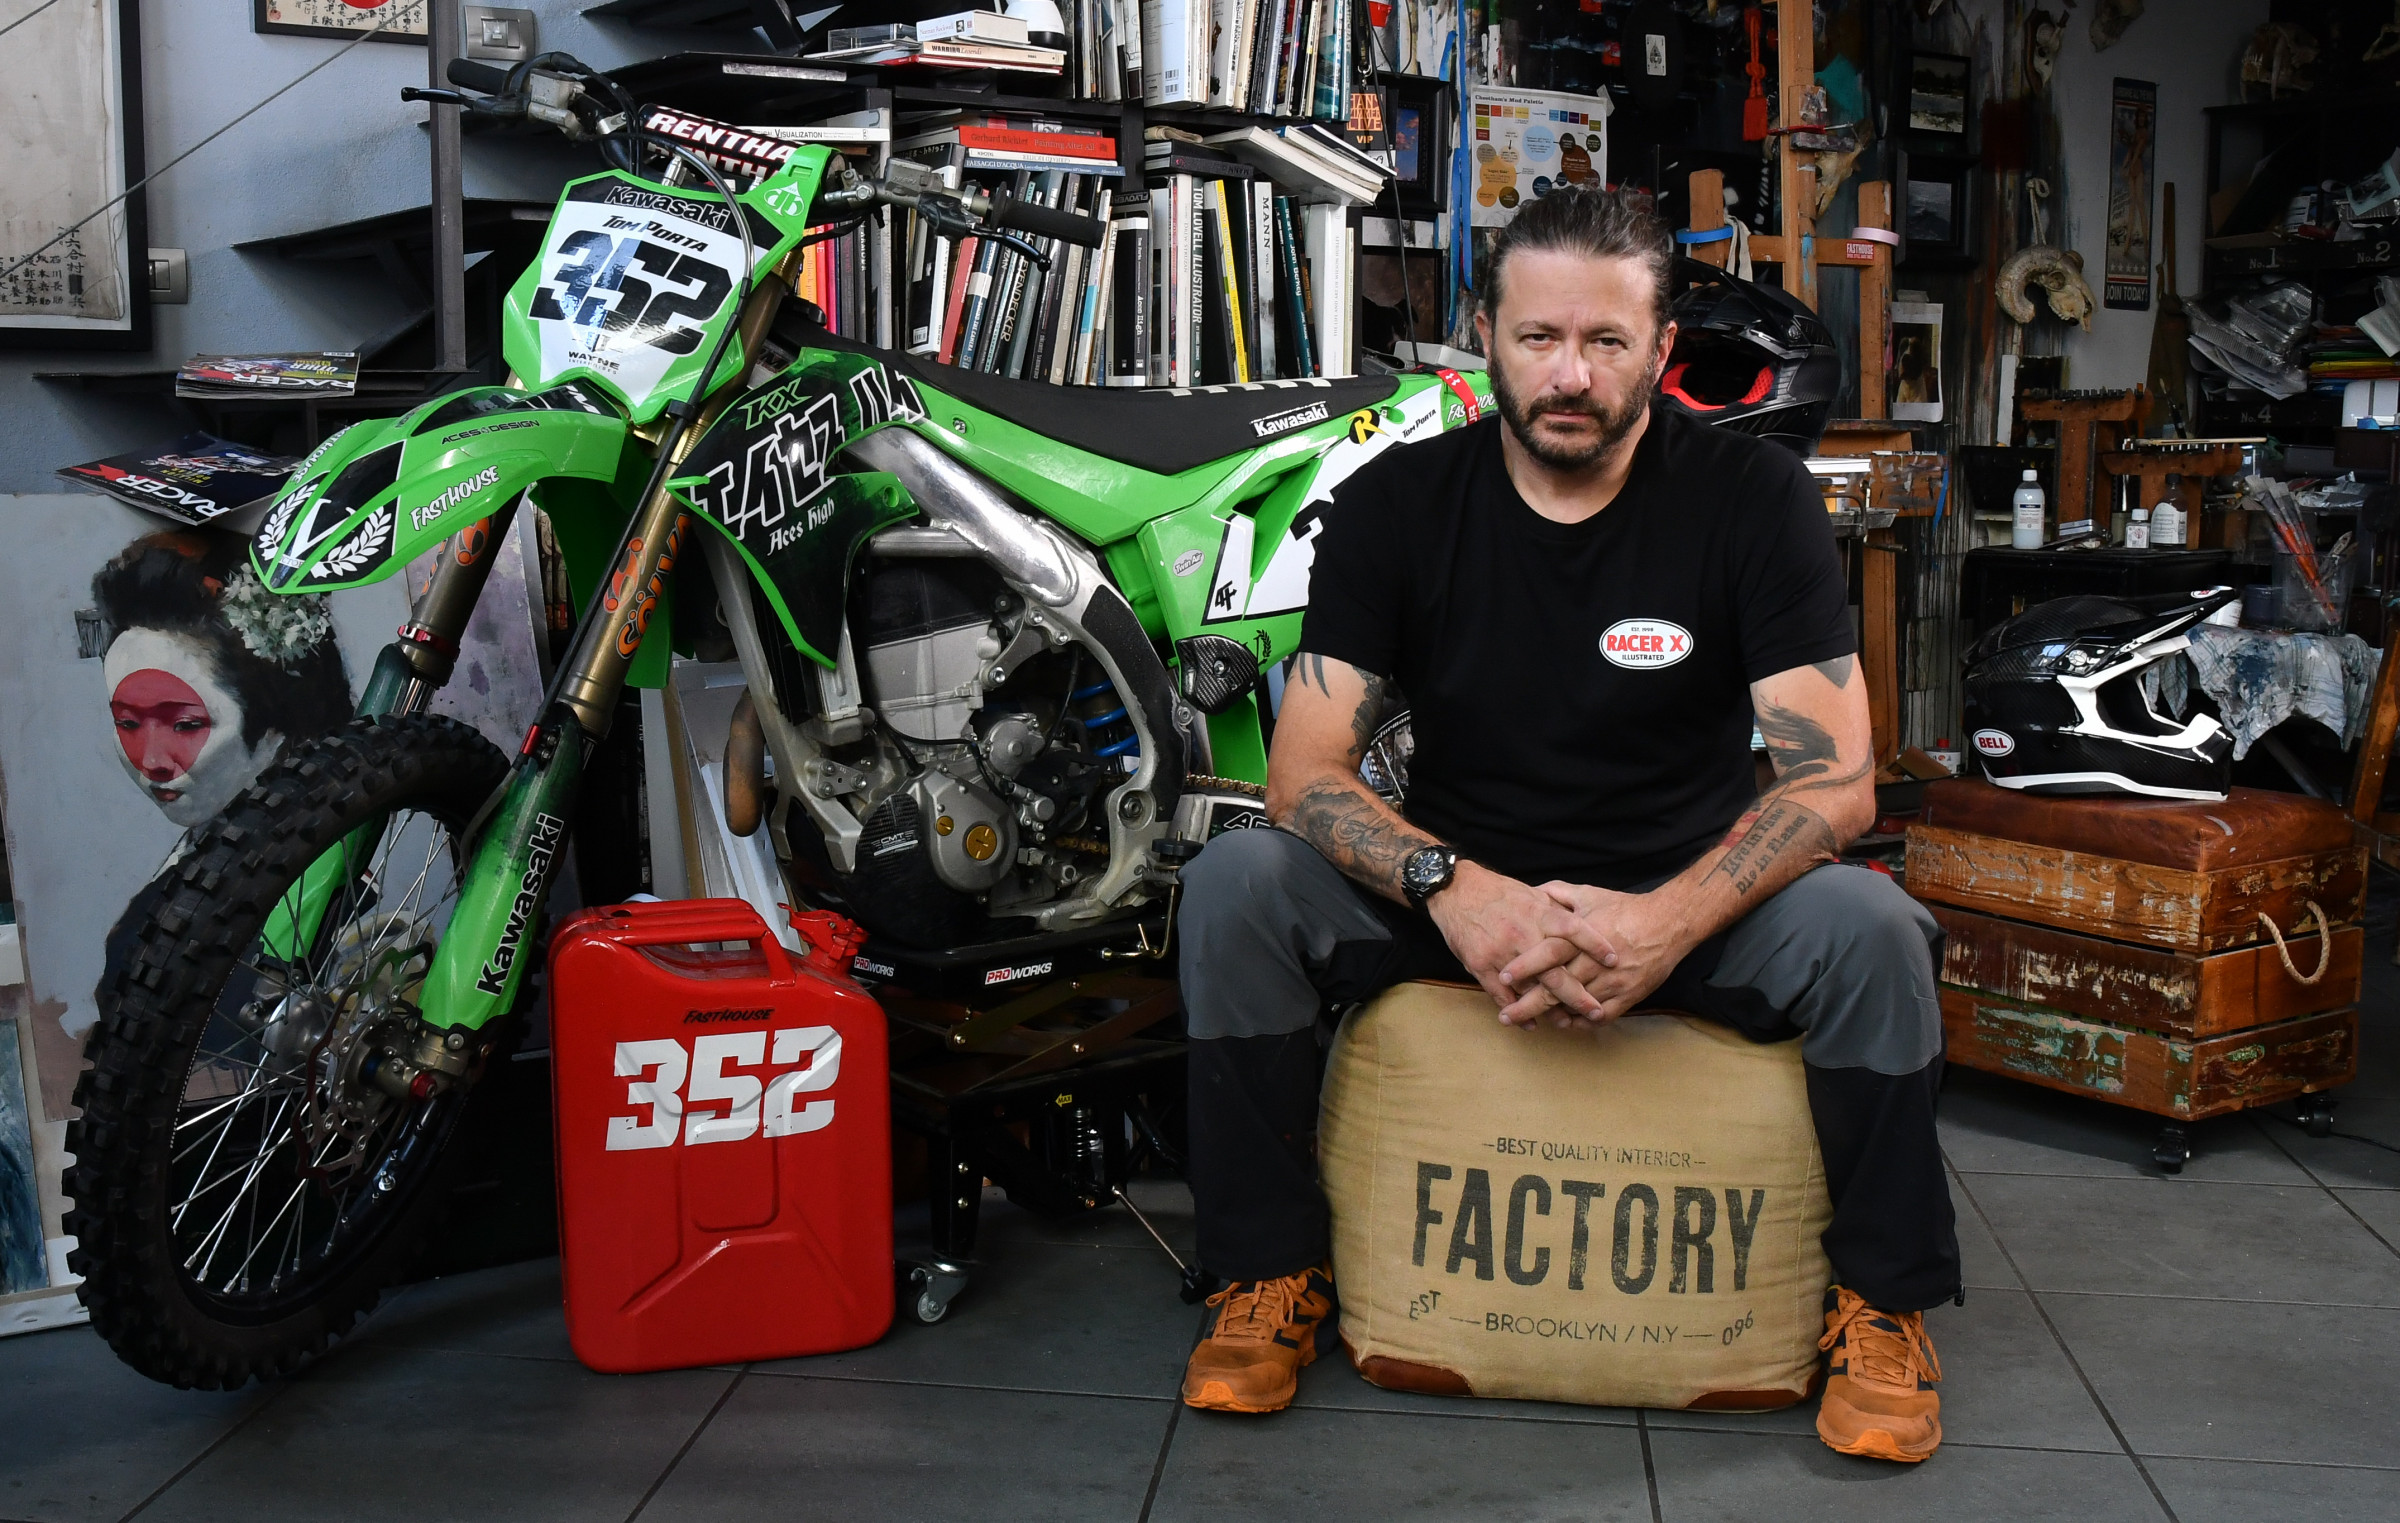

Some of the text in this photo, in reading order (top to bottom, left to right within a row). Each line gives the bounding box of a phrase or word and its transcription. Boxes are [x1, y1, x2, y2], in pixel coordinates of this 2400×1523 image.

[646, 111, 798, 163] RENTHA
[1348, 119, 1382, 130] LIVE
[604, 186, 730, 231] Kawasaki
[602, 214, 708, 253] TOM PORTA
[1262, 196, 1270, 250] MANN
[1288, 233, 1294, 241] of
[1192, 186, 1204, 323] TOM LOVELL ILLUSTRATOR
[1290, 244, 1298, 264] John
[527, 229, 733, 356] 352
[1293, 267, 1302, 297] Berkey
[2106, 284, 2148, 301] JOIN TODAY!
[1000, 258, 1029, 343] EYENDECKER
[1136, 315, 1144, 336] High
[290, 362, 338, 372] OTHER
[568, 350, 620, 371] WAYNE
[233, 372, 354, 388] RACER
[737, 377, 813, 431] KX
[1253, 402, 1330, 438] Kawasaki
[1416, 409, 1437, 428] PORTA
[441, 420, 540, 446] ACES DESIGN
[116, 474, 232, 518] RACER
[410, 466, 500, 532] FASTHOUSE
[767, 521, 804, 556] Aces
[1606, 634, 1684, 652] RACER X
[1978, 736, 2008, 750] BELL
[880, 832, 904, 844] CMT
[1755, 854, 1773, 872] in
[476, 812, 564, 997] Kawasaki
[854, 955, 894, 978] PROWORKS
[985, 962, 1052, 984] PROWORKS
[684, 1008, 774, 1024] FASTHOUSE
[606, 1025, 842, 1151] 352
[1057, 1094, 1072, 1104] MAX
[1497, 1137, 1692, 1168] BEST QUALITY INTERIOR
[1412, 1161, 1765, 1295] FACTORY
[1485, 1312, 1618, 1343] BROOKLYN
[1722, 1308, 1754, 1347] 096
